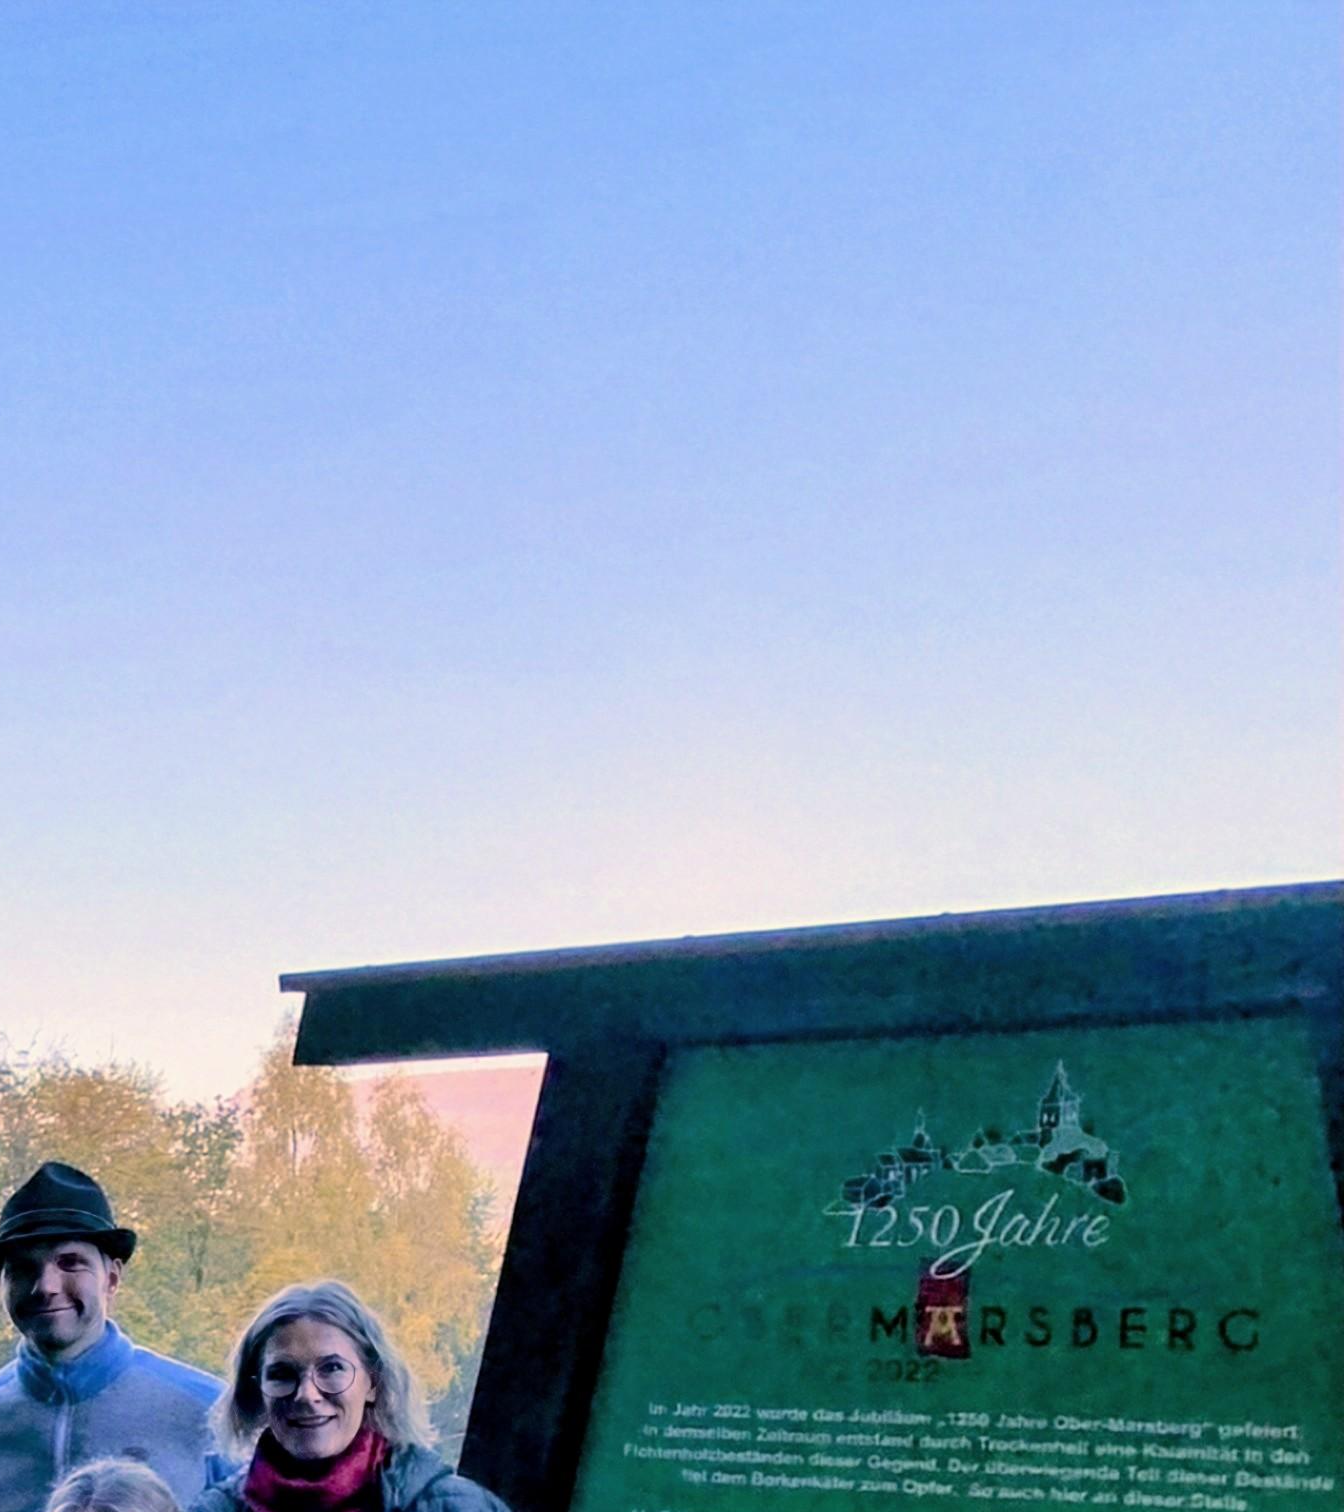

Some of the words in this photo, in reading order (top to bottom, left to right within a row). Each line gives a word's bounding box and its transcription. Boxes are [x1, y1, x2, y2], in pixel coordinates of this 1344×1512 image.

[841, 1204, 960, 1248] 1250
[929, 1188, 1111, 1280] Jahre
[649, 1402, 666, 1415] Im
[672, 1403, 705, 1416] Jahr
[714, 1405, 749, 1418] 2022
[756, 1407, 807, 1420] wurde
[812, 1408, 843, 1422] das
[848, 1410, 931, 1425] Jubiläum
[996, 1415, 1046, 1429] Jahre
[643, 1422, 657, 1435] In
[664, 1423, 750, 1439] demselben
[756, 1427, 831, 1442] Zeitraum
[836, 1431, 913, 1446] entstand
[919, 1434, 972, 1448] durch
[978, 1437, 1088, 1453] Trockenheit
[1094, 1442, 1136, 1455] eine
[1142, 1444, 1238, 1460] Kalamität
[1244, 1448, 1263, 1461] in
[1270, 1449, 1310, 1463] den
[623, 1443, 804, 1463] Fichtenholzbeständen
[808, 1451, 862, 1466] dieser
[947, 1458, 979, 1472] Der
[984, 1460, 1120, 1480] überwiegende
[1128, 1467, 1160, 1480] Teil
[1167, 1469, 1227, 1483] dieser
[1234, 1472, 1334, 1488] Bestände
[682, 1469, 706, 1482] fiel
[710, 1470, 746, 1484] dem
[752, 1472, 854, 1490] Borkenkäfer
[858, 1481, 896, 1492] zum
[968, 1484, 993, 1497] So
[998, 1487, 1044, 1499] auch
[1050, 1488, 1086, 1502] hier
[1091, 1493, 1117, 1503] an
[1122, 1491, 1184, 1507] dieser
